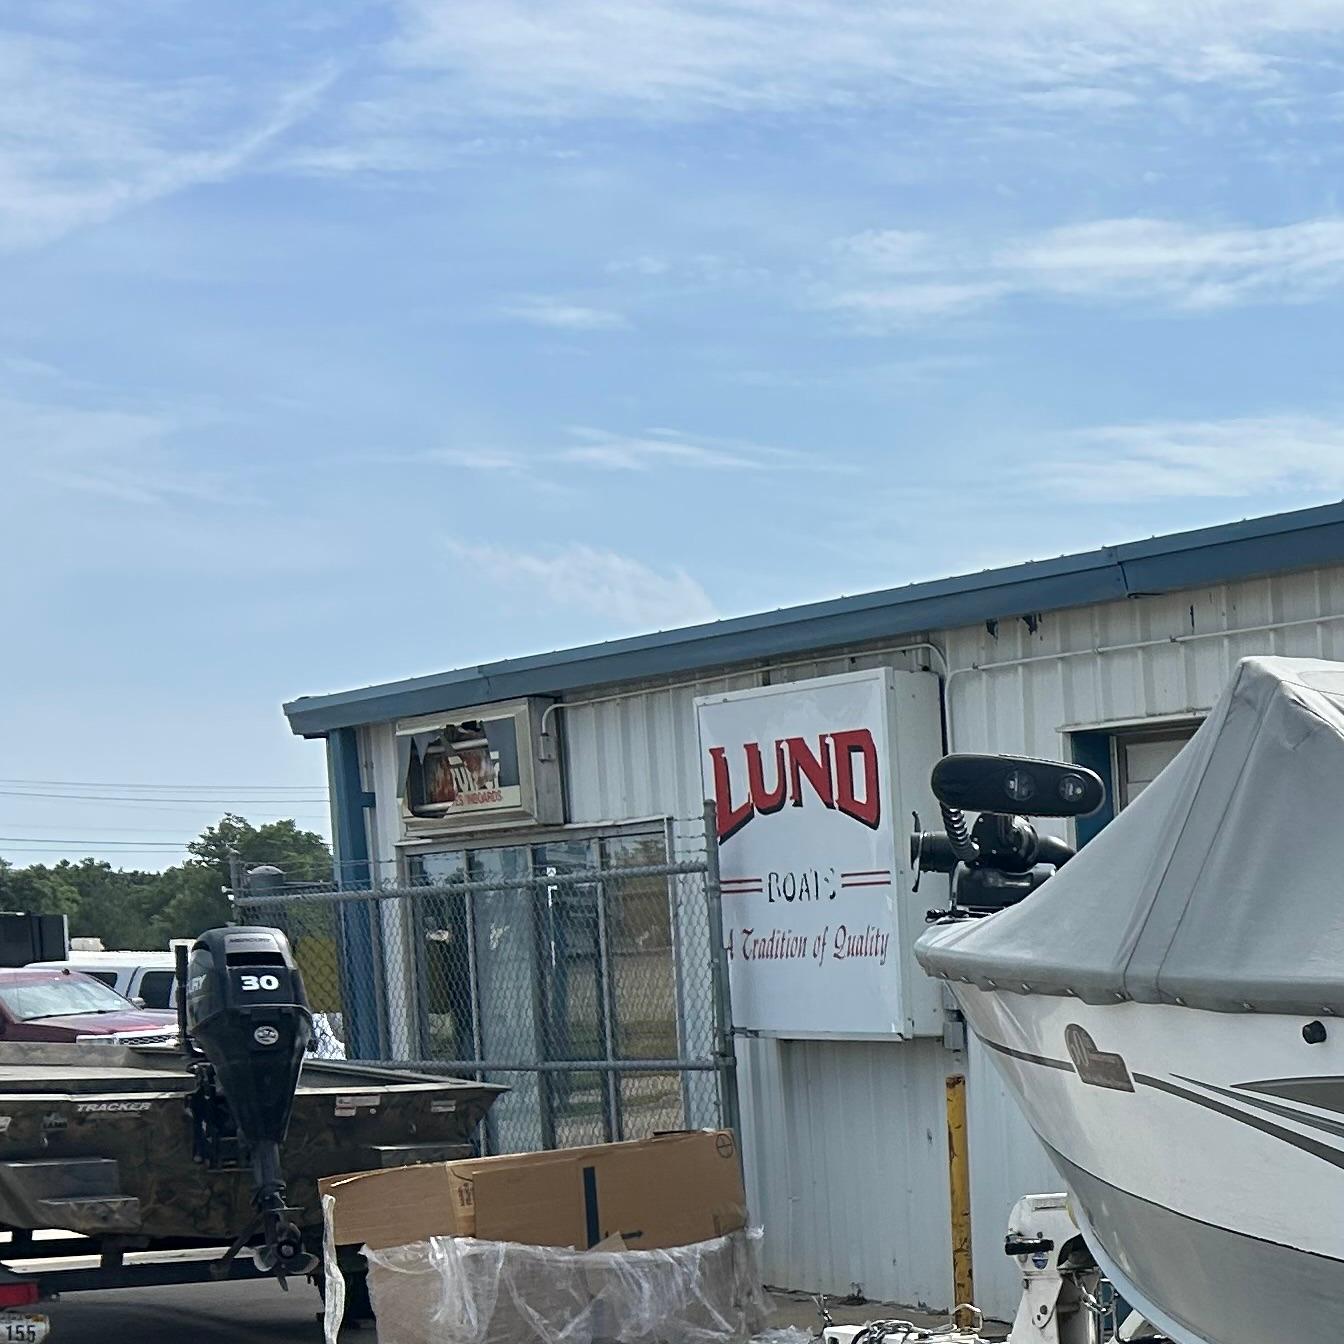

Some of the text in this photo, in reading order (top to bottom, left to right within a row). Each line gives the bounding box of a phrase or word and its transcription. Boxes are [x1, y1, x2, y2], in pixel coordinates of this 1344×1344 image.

[709, 727, 881, 846] LUND
[742, 928, 808, 961] Tradition
[813, 926, 830, 966] of
[833, 925, 890, 966] Quality
[241, 975, 279, 991] 30
[77, 1103, 152, 1112] TRACKER
[6, 1325, 36, 1343] 155
